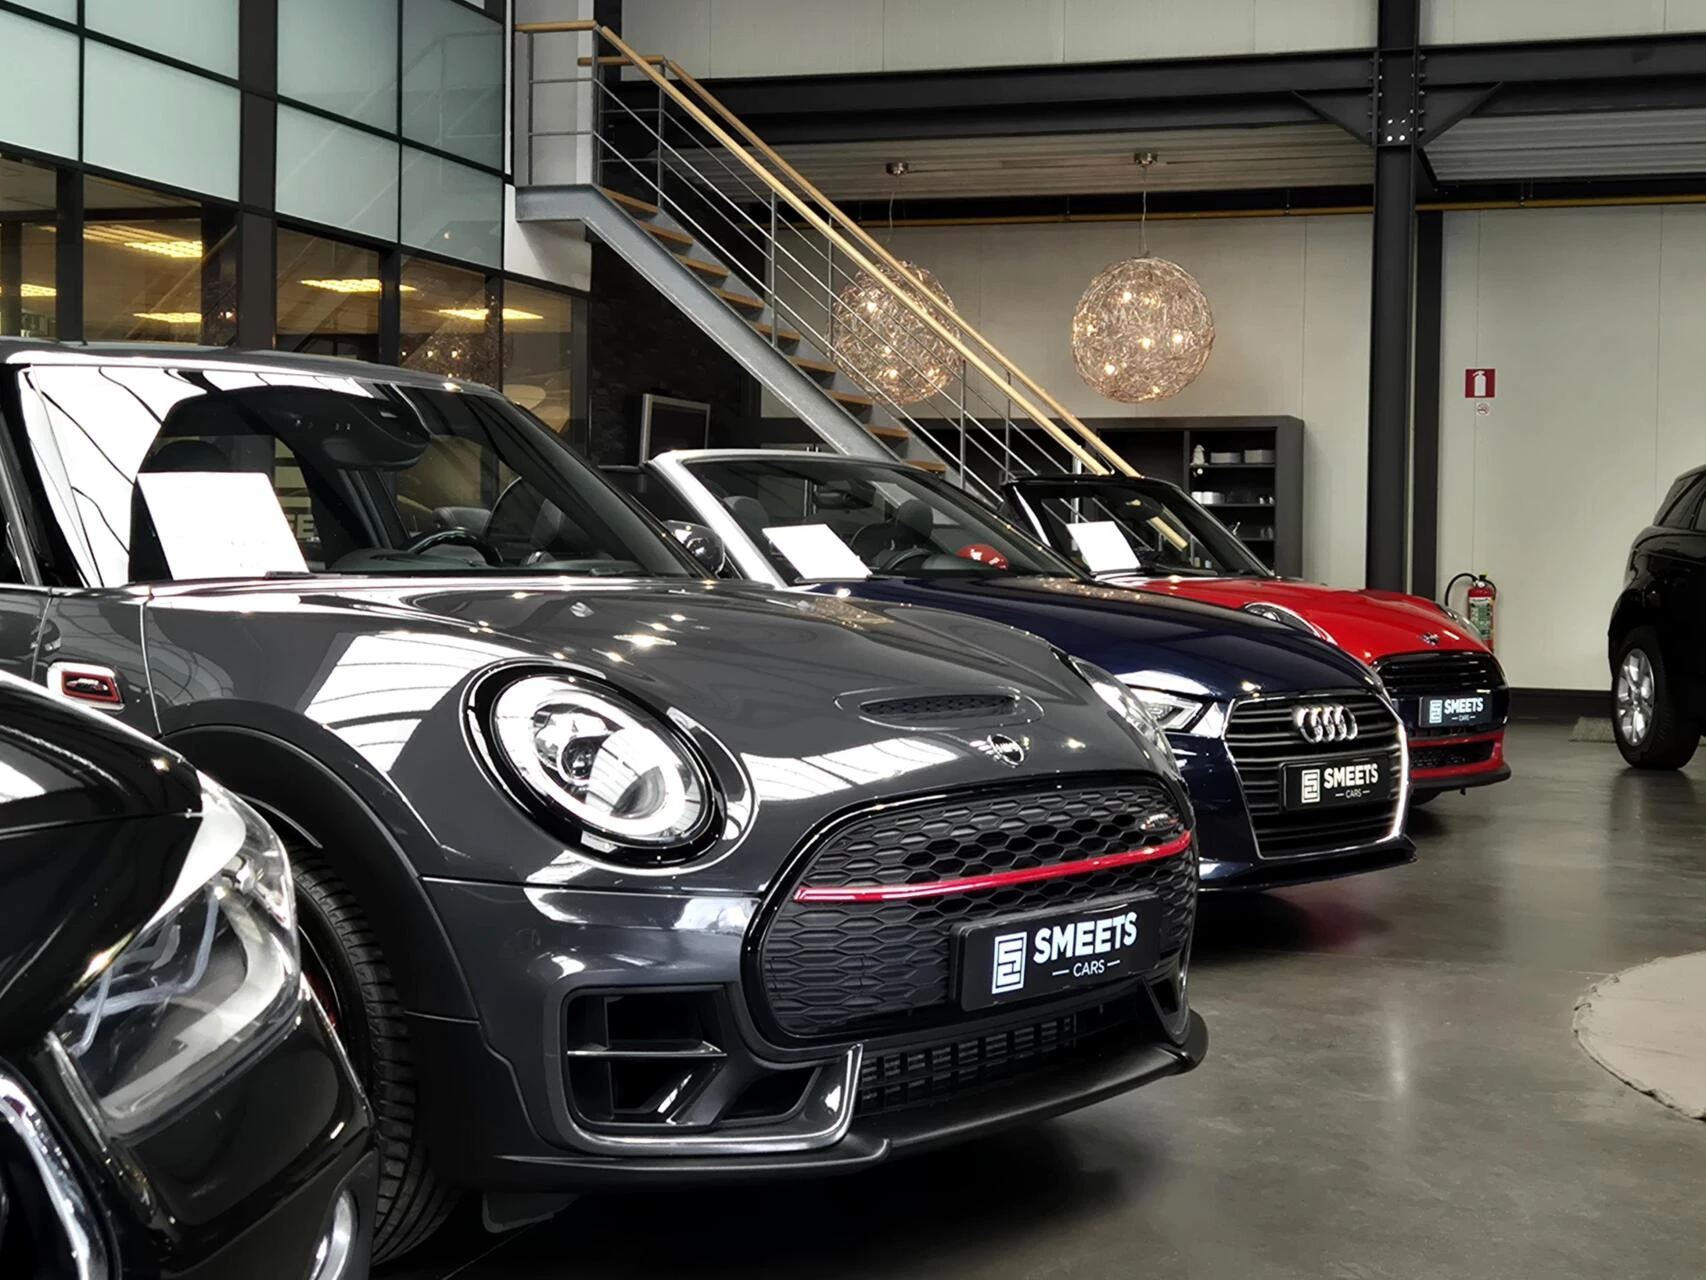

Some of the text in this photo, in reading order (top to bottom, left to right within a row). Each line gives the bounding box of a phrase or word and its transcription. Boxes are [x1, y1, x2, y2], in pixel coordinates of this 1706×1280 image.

[1444, 697, 1483, 714] SMEETS
[1323, 763, 1379, 789] SMEETS
[1345, 788, 1362, 799] CARS
[1033, 911, 1137, 964] SMEETS
[1072, 959, 1105, 977] CARS
